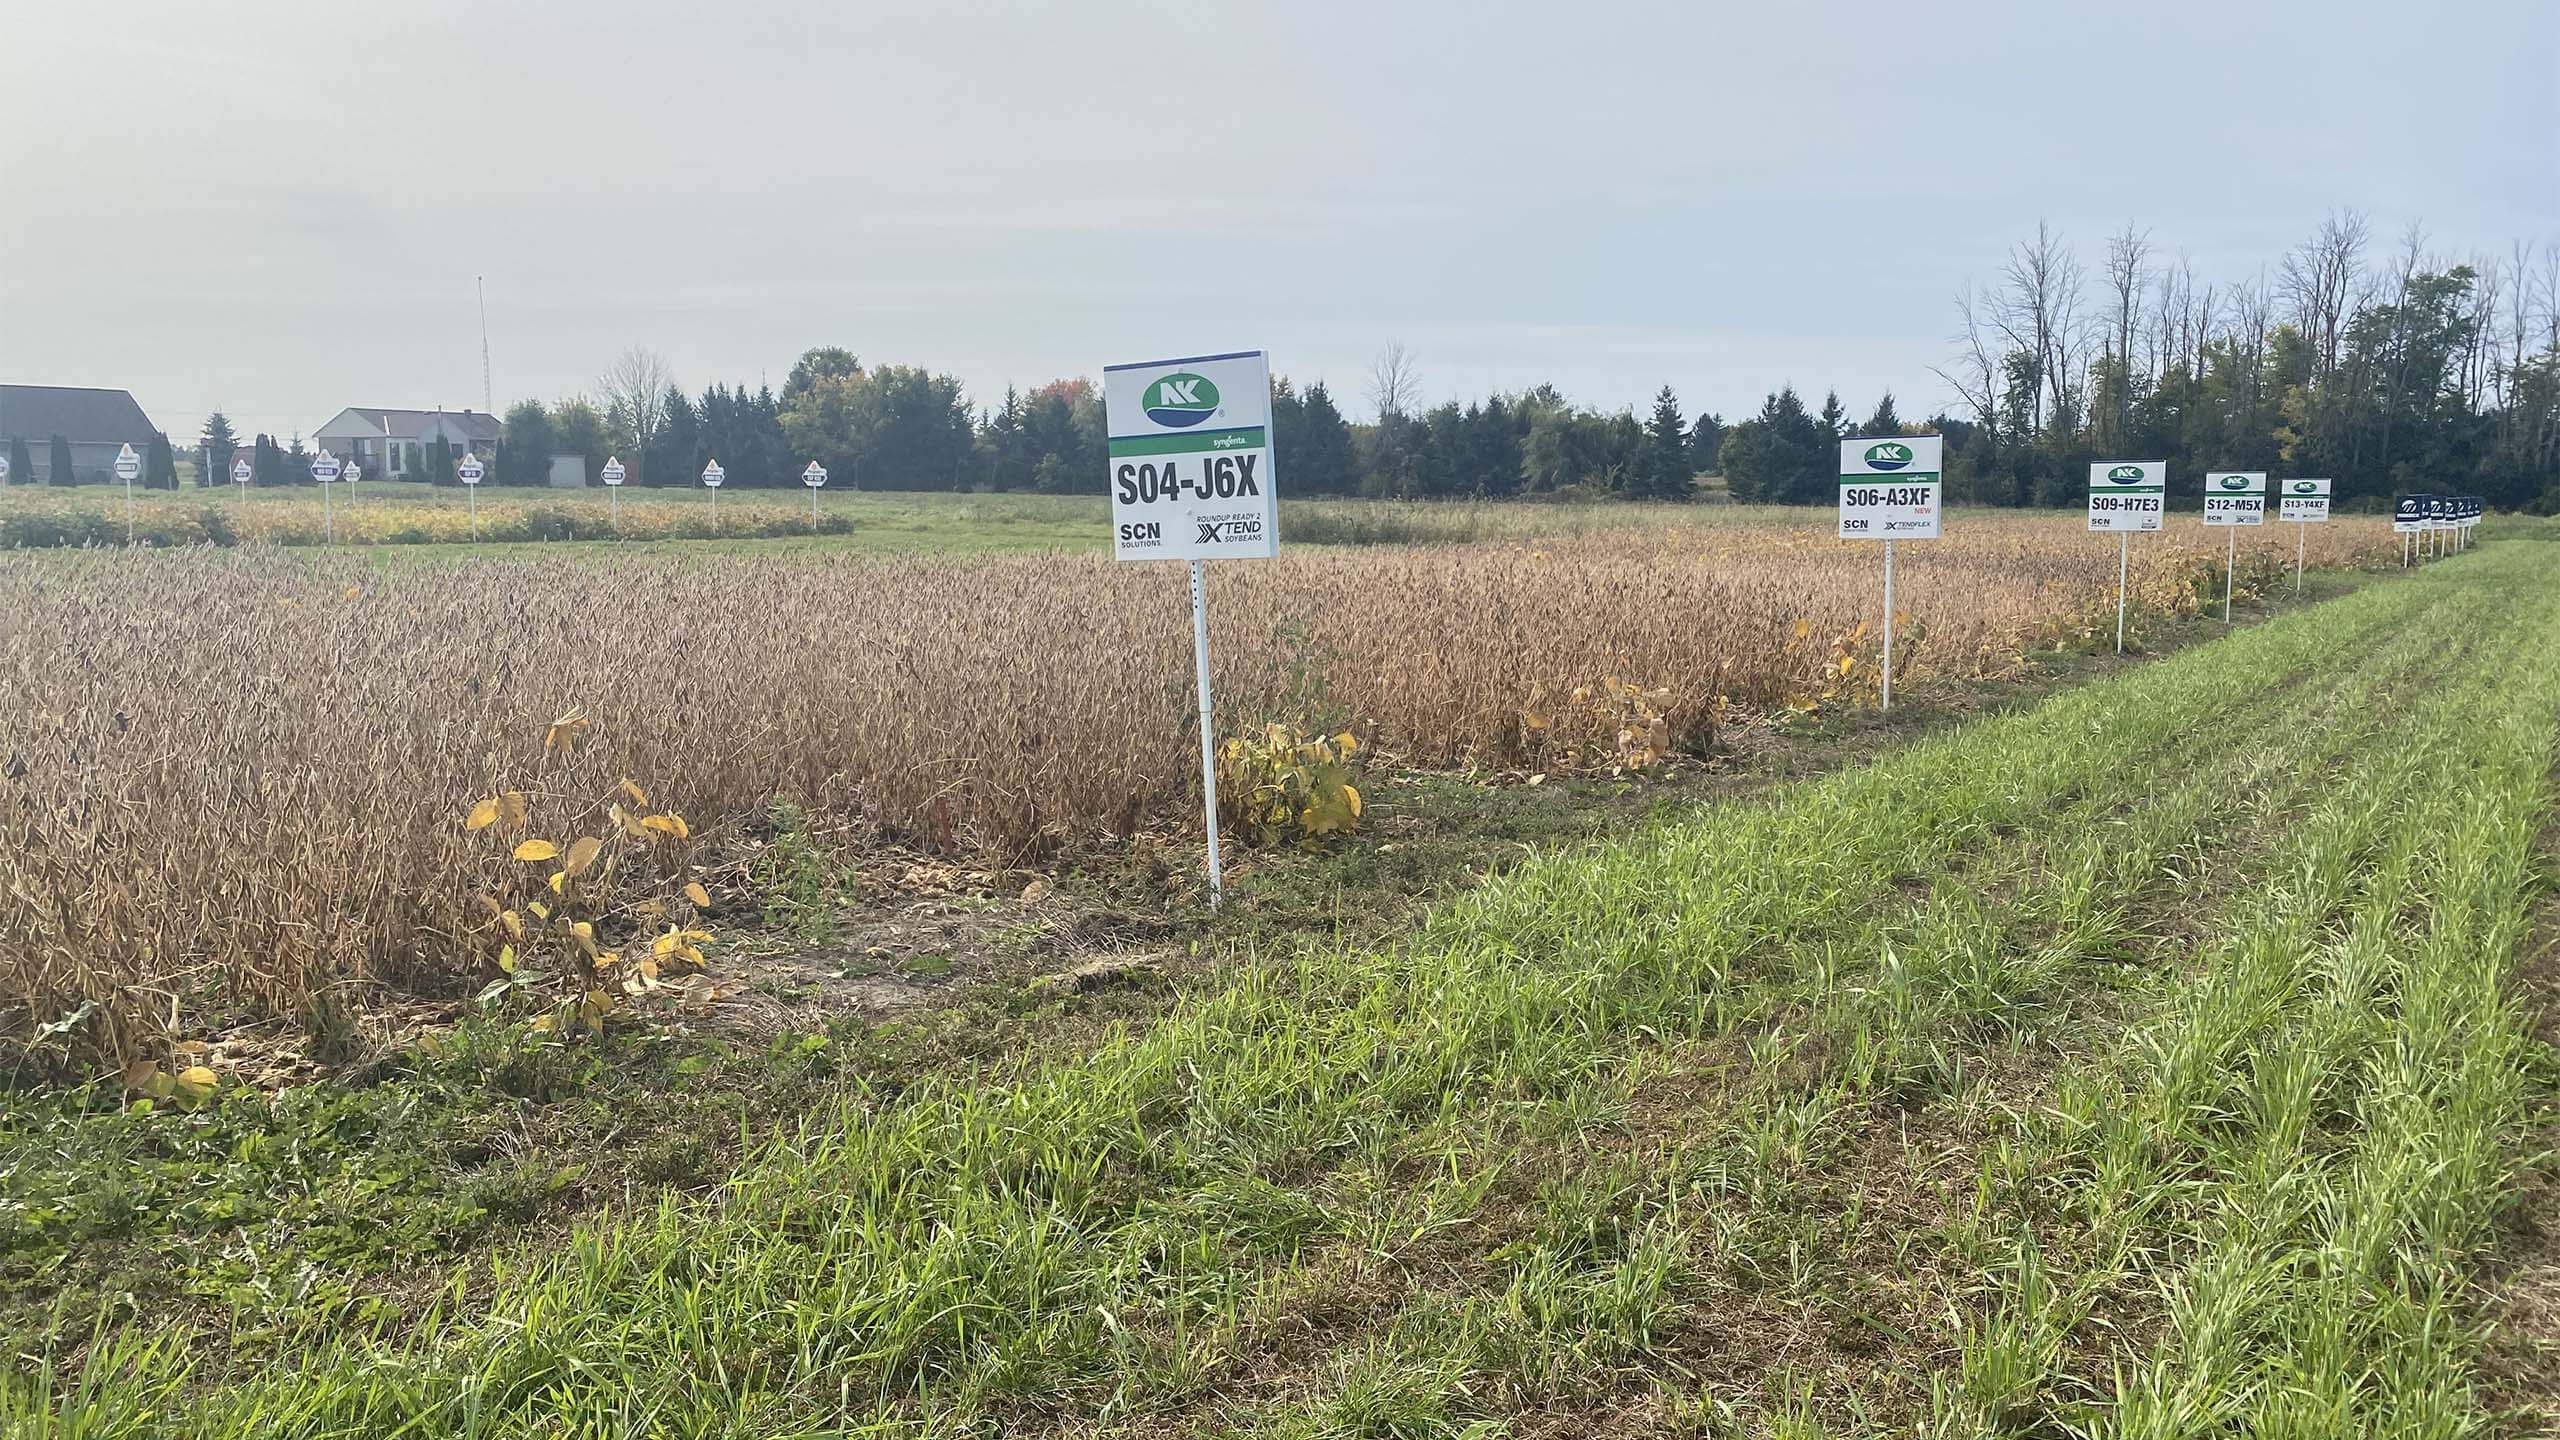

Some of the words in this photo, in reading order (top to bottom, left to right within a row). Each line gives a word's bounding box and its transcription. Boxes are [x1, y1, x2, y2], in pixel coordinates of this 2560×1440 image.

[1159, 379, 1201, 406] NK
[1213, 435, 1247, 449] syngenta
[1876, 447, 1903, 459] NK
[2117, 468, 2137, 477] NK
[1117, 454, 1260, 505] S04-J6X
[1846, 488, 1931, 506] S06-A3XF
[2092, 497, 2159, 511] S09-H7E3
[2207, 499, 2262, 511] S12-M5X
[1196, 515, 1231, 523] ROUNDUP
[1232, 513, 1255, 521] READY
[1843, 519, 1869, 529] SCN
[1120, 522, 1161, 540] SCN
[1121, 540, 1161, 549] SOLUTIONS
[1224, 534, 1262, 543] SOYBEANS
